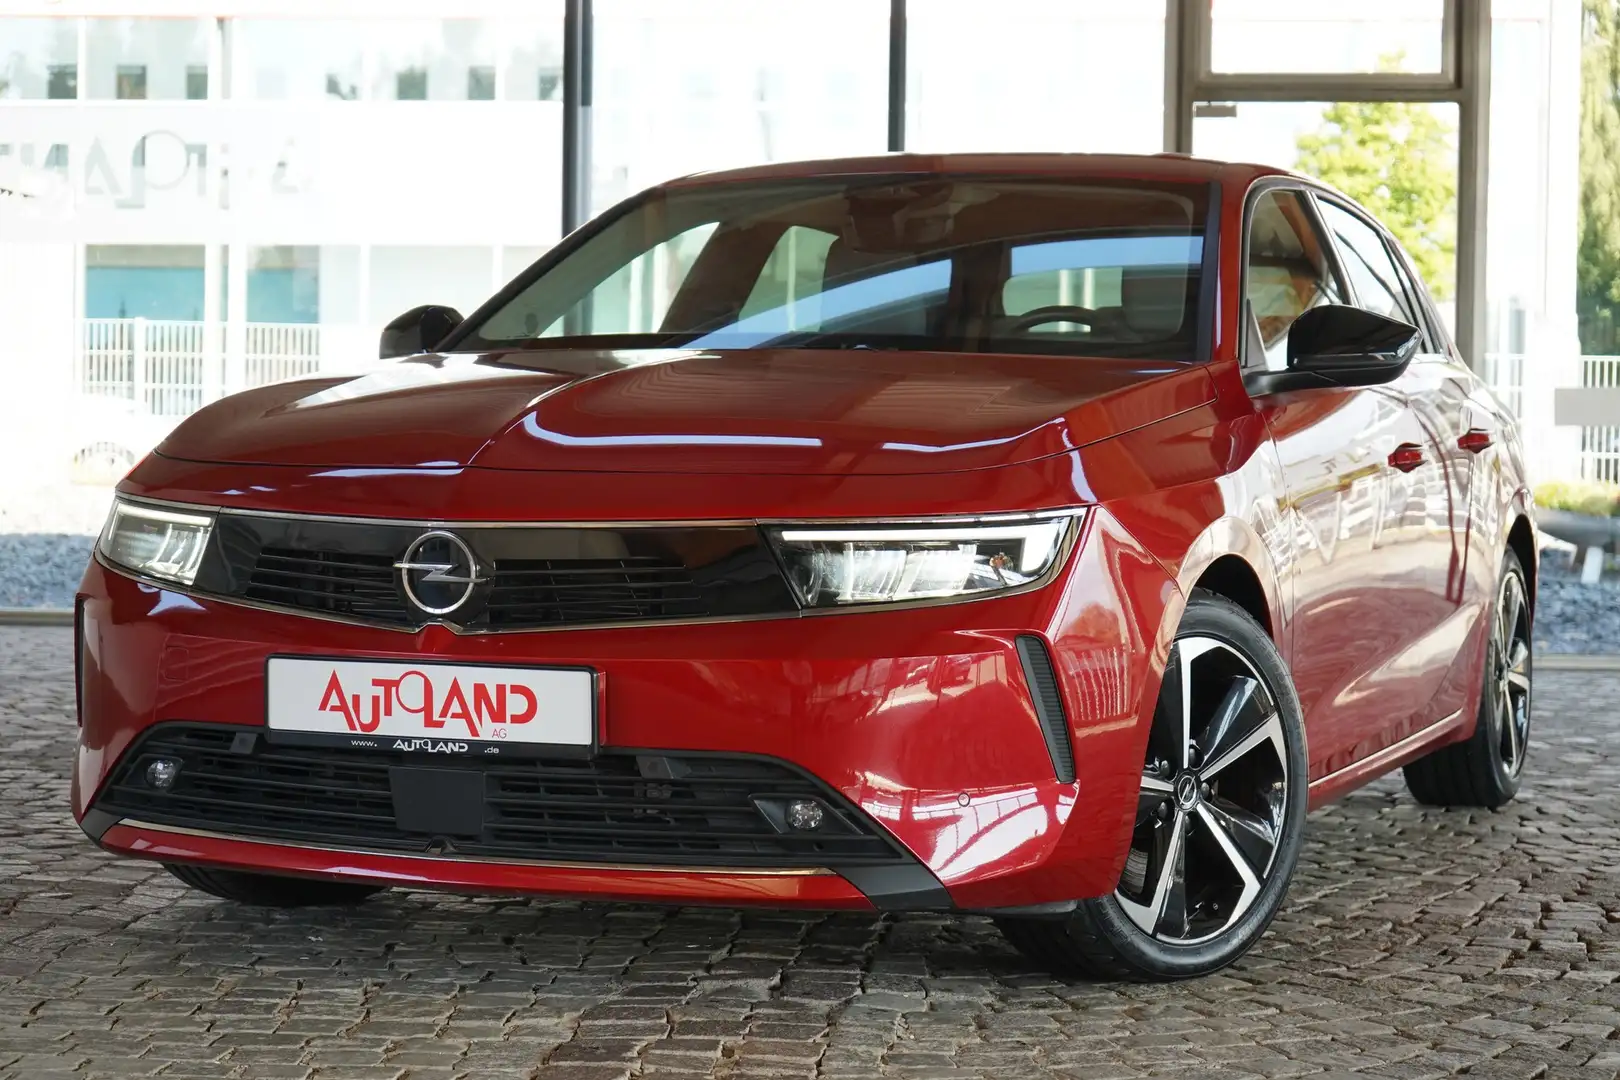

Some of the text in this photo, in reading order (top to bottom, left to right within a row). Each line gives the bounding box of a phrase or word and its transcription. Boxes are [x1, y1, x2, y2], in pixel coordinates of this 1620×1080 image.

[319, 669, 538, 738] AUTOLAND
[491, 727, 508, 739] AG
[351, 740, 378, 748] www.
[392, 738, 469, 754] AUTOLAND
